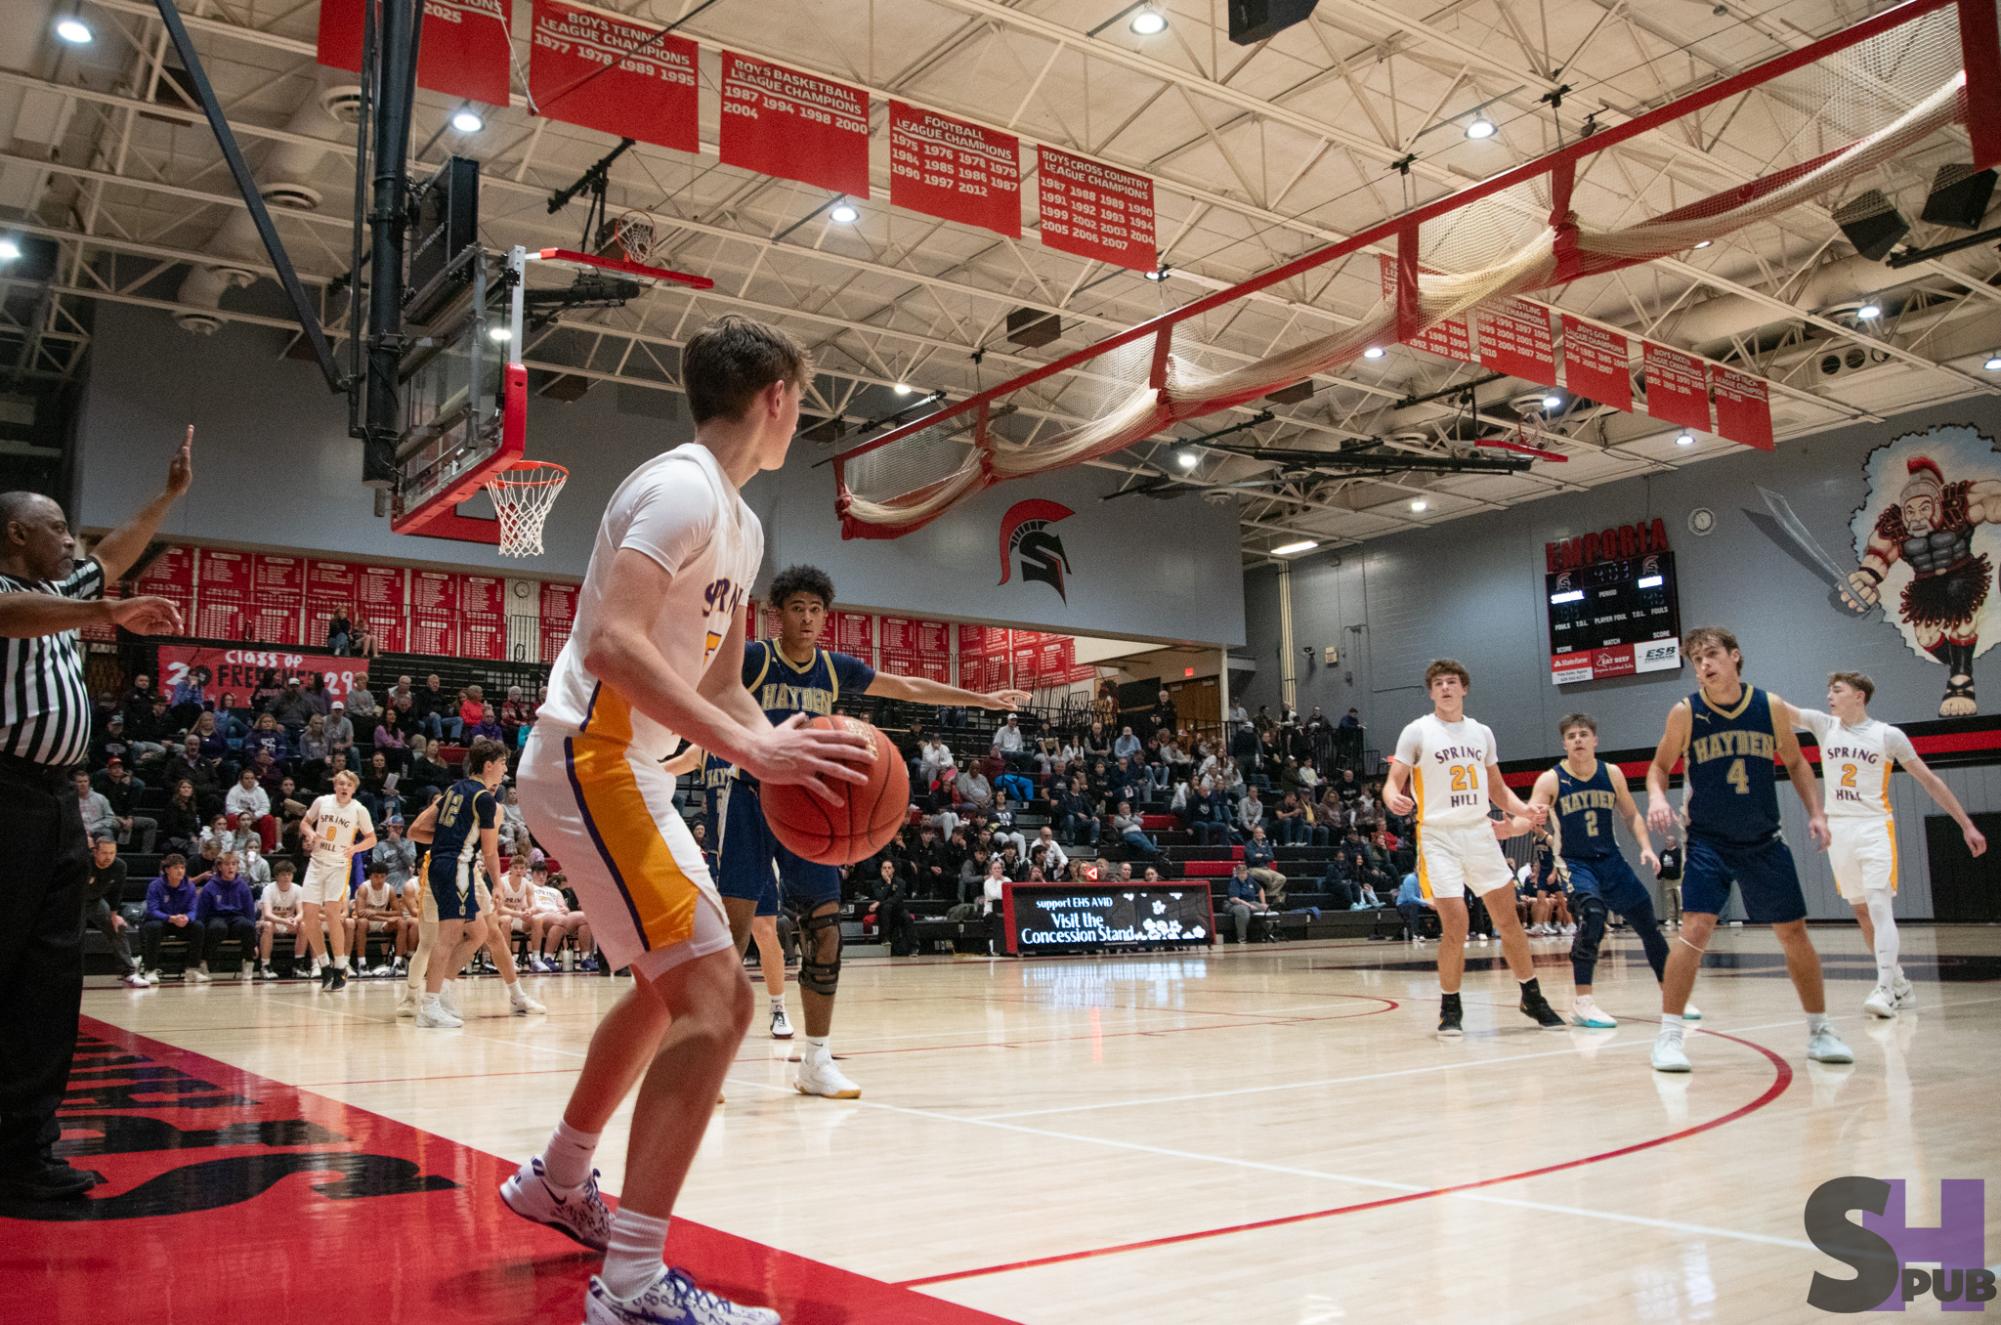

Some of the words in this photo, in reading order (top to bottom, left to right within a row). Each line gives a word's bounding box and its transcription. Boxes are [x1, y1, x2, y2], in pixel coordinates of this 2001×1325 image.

[424, 2, 462, 24] 2025
[541, 16, 599, 42] LEAGUE
[603, 34, 690, 65] CHAMPIONS
[568, 12, 609, 31] BOYS
[610, 24, 665, 47] TENNIS
[535, 33, 570, 54] 1977
[577, 46, 613, 66] 1978
[619, 57, 655, 76] 1989
[660, 69, 695, 87] 1995
[731, 68, 782, 92] LEAGUE
[784, 84, 862, 114] CHAMPIONS
[734, 59, 771, 76] BOYS
[773, 70, 858, 102] BASKETBALL
[723, 102, 759, 119] 2004
[724, 86, 759, 102] 1987
[762, 96, 795, 114] 1994
[799, 107, 832, 124] 1998
[835, 117, 868, 135] 2000
[897, 117, 942, 139] LEAGUE
[945, 132, 1012, 160] CHAMPIONS
[924, 115, 985, 141] FOOTBALL
[892, 133, 918, 151] 1975
[923, 144, 953, 160] 1976
[959, 152, 986, 168] 1978
[990, 162, 1017, 178] 1979
[892, 148, 919, 166] 1984
[924, 159, 954, 175] 1985
[959, 168, 987, 183] 1986
[991, 177, 1018, 192] 1987
[1042, 150, 1069, 166] BOYS
[1071, 160, 1103, 177] CROSS
[1104, 170, 1149, 190] COUNTRY
[892, 163, 920, 180] 1990
[924, 174, 954, 189] 1997
[959, 182, 988, 197] 2012
[1045, 163, 1085, 182] LEAGUE
[1088, 175, 1148, 200] CHAMPIONS
[1042, 191, 1068, 206] 1991
[1071, 201, 1096, 216] 1992
[1101, 209, 1125, 224] 1993
[1130, 217, 1154, 231] 1994
[1070, 186, 1096, 201] 1988
[1100, 194, 1125, 210] 1989
[1128, 203, 1153, 217] 1990
[1041, 205, 1068, 220] 1999
[1100, 223, 1127, 237] 2003
[1130, 230, 1155, 245] 2004
[1042, 219, 1069, 235] 2005
[1102, 236, 1128, 250] 2007
[1545, 518, 1669, 574] EMPORIA
[1595, 615, 1613, 624] PLAYER
[1651, 606, 1668, 615] FOULS
[1653, 630, 1670, 639] SCORE
[324, 672, 353, 695] 29
[761, 683, 832, 715] HAYDEN
[1434, 745, 1483, 764] SPRING
[1693, 730, 1776, 763] HAYDEN
[1827, 747, 1879, 765] SPRING
[1449, 764, 1479, 792] 21
[1726, 758, 1750, 795] 4
[1841, 763, 1857, 787] 2
[1451, 793, 1478, 809] HILL
[1560, 790, 1617, 816] HAYDEN
[1836, 789, 1862, 802] HILL
[320, 814, 350, 829] SPRING
[1584, 810, 1599, 837] 2
[320, 841, 336, 853] HILL
[1036, 898, 1071, 910] support
[1072, 897, 1090, 907] EHS
[1091, 897, 1113, 907] AVID
[1021, 927, 1097, 944] Concession
[1099, 926, 1136, 942] Stand
[1051, 912, 1080, 928] Visit
[1082, 914, 1104, 928] the
